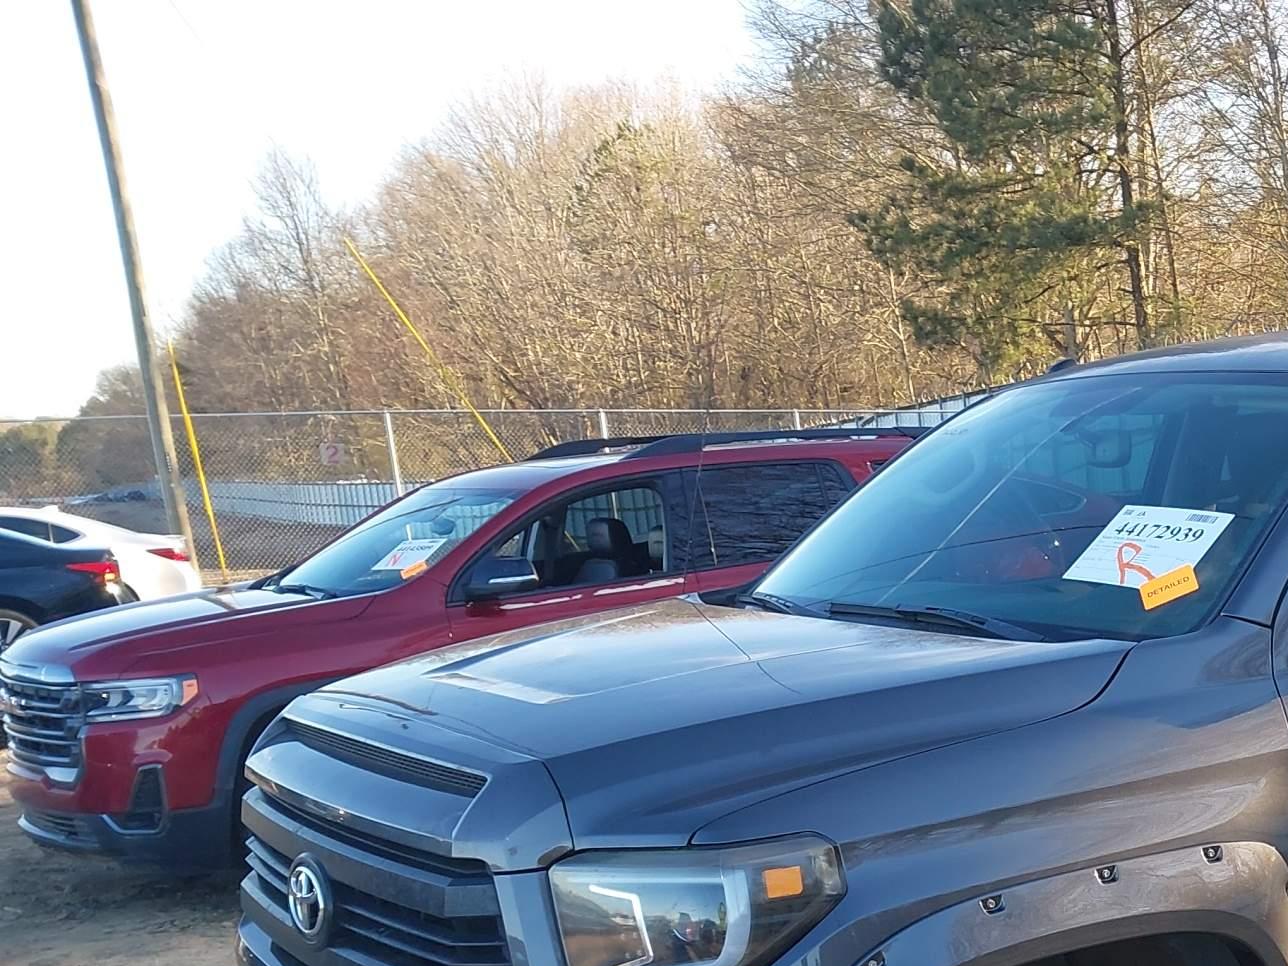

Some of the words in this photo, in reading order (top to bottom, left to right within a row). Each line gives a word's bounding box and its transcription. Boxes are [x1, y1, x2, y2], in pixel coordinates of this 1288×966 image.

[326, 445, 339, 464] 2
[1115, 521, 1205, 543] 44172939
[1117, 542, 1157, 585] R
[1147, 575, 1190, 598] DETAILED
